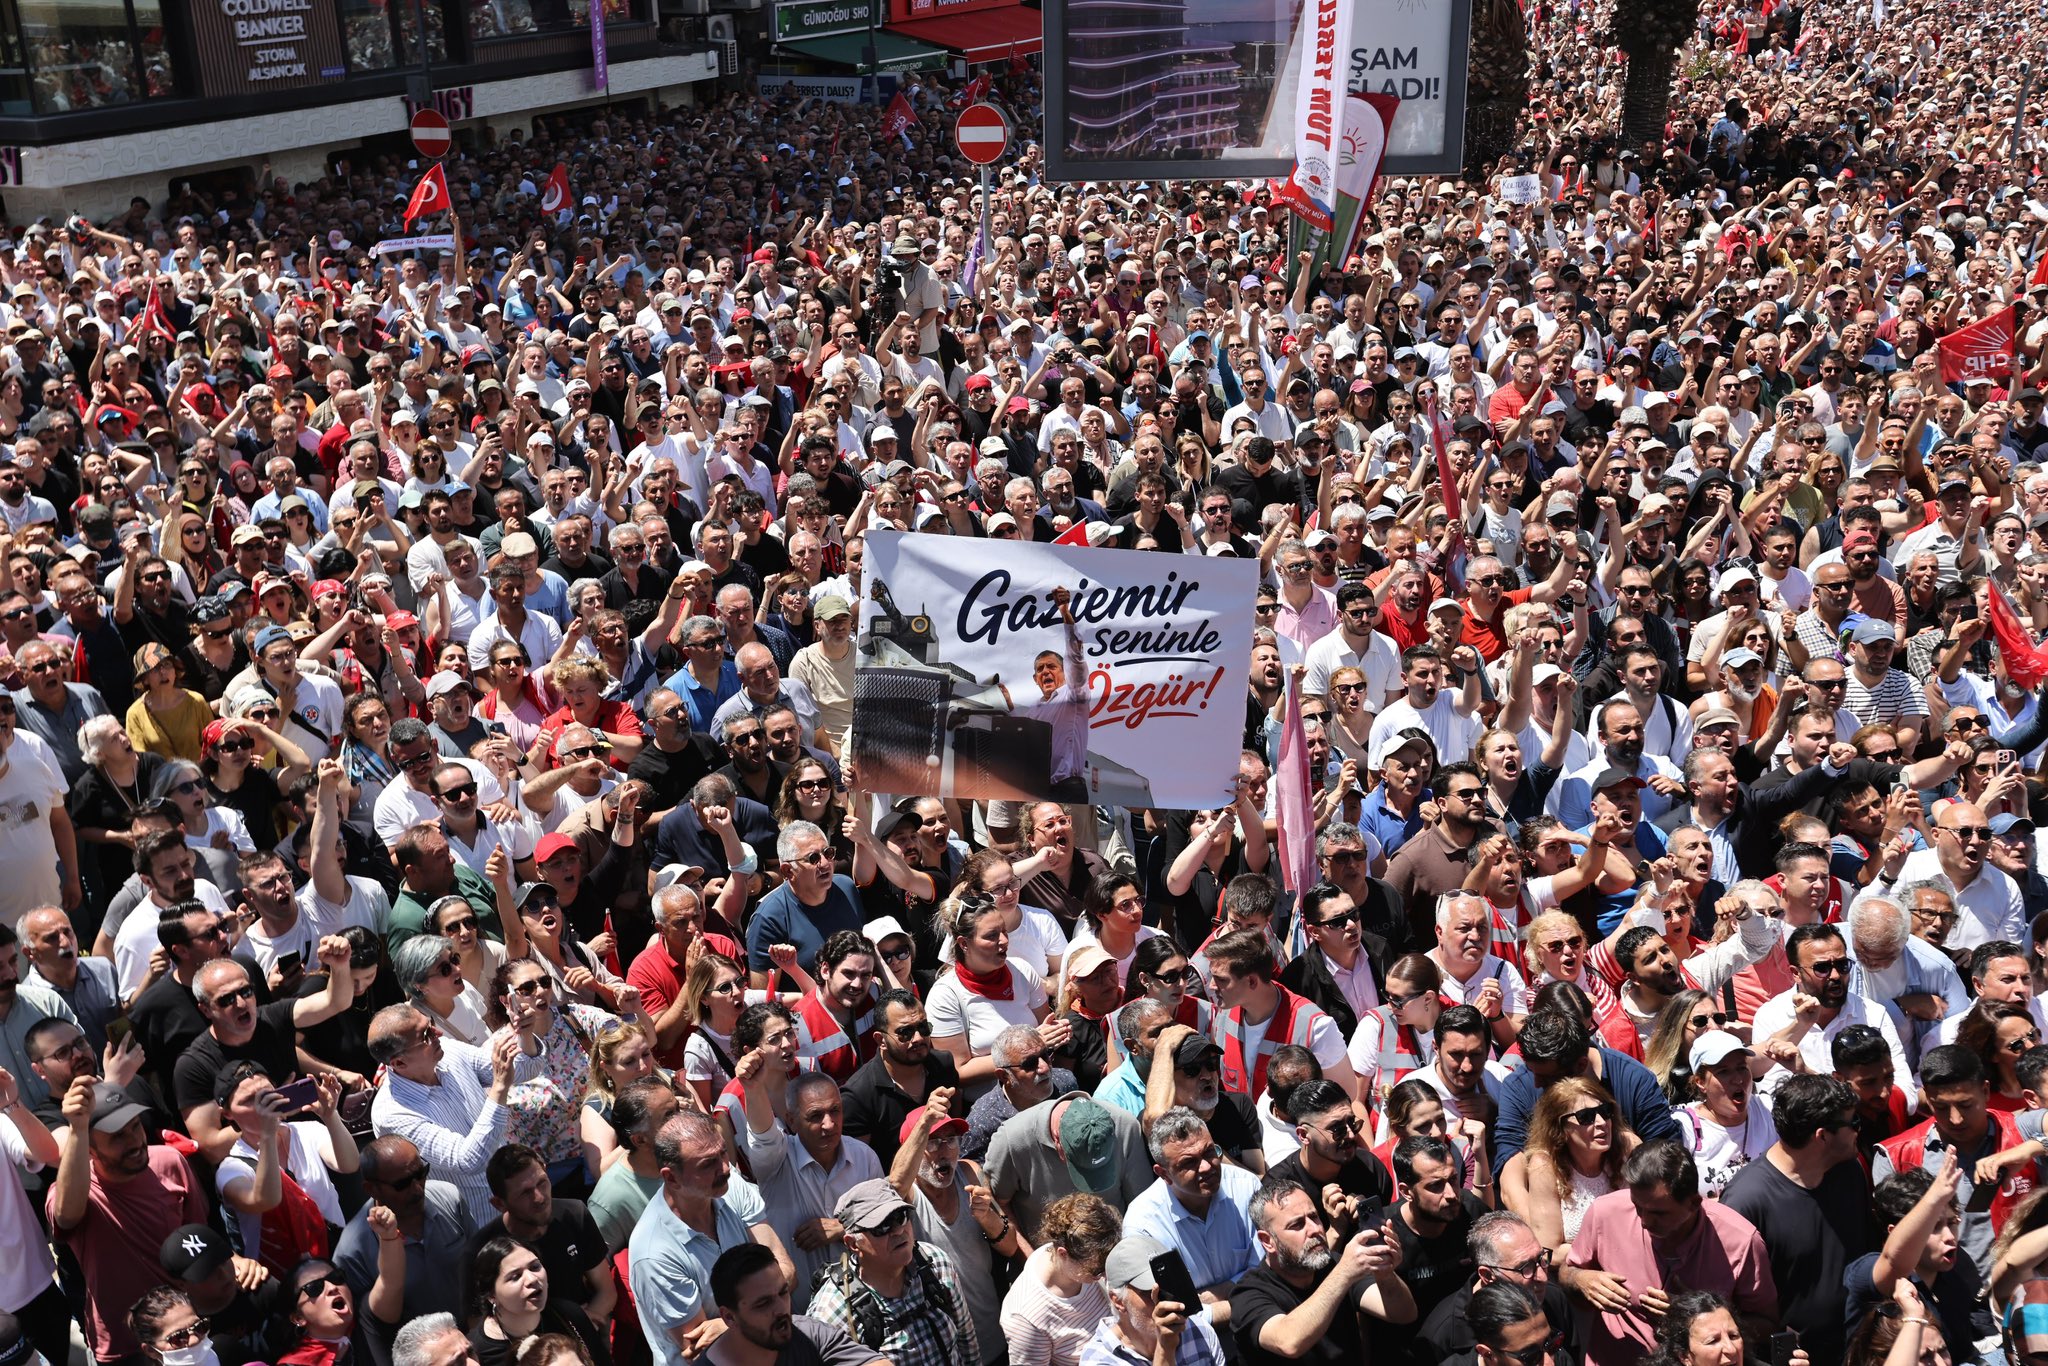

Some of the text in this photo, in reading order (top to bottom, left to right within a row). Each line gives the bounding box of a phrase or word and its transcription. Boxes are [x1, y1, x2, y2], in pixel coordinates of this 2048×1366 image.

[222, 0, 311, 16] COLDWELL
[803, 6, 869, 26] GÜNDOĞDU SHO
[235, 15, 304, 39] BANKER
[255, 47, 297, 64] STORM
[1351, 46, 1418, 78] ŞAM
[248, 63, 307, 82] ALSANCAK
[957, 569, 1199, 645] Gaziemir
[1087, 619, 1221, 657] seninle
[1088, 662, 1225, 729] Özgür!
